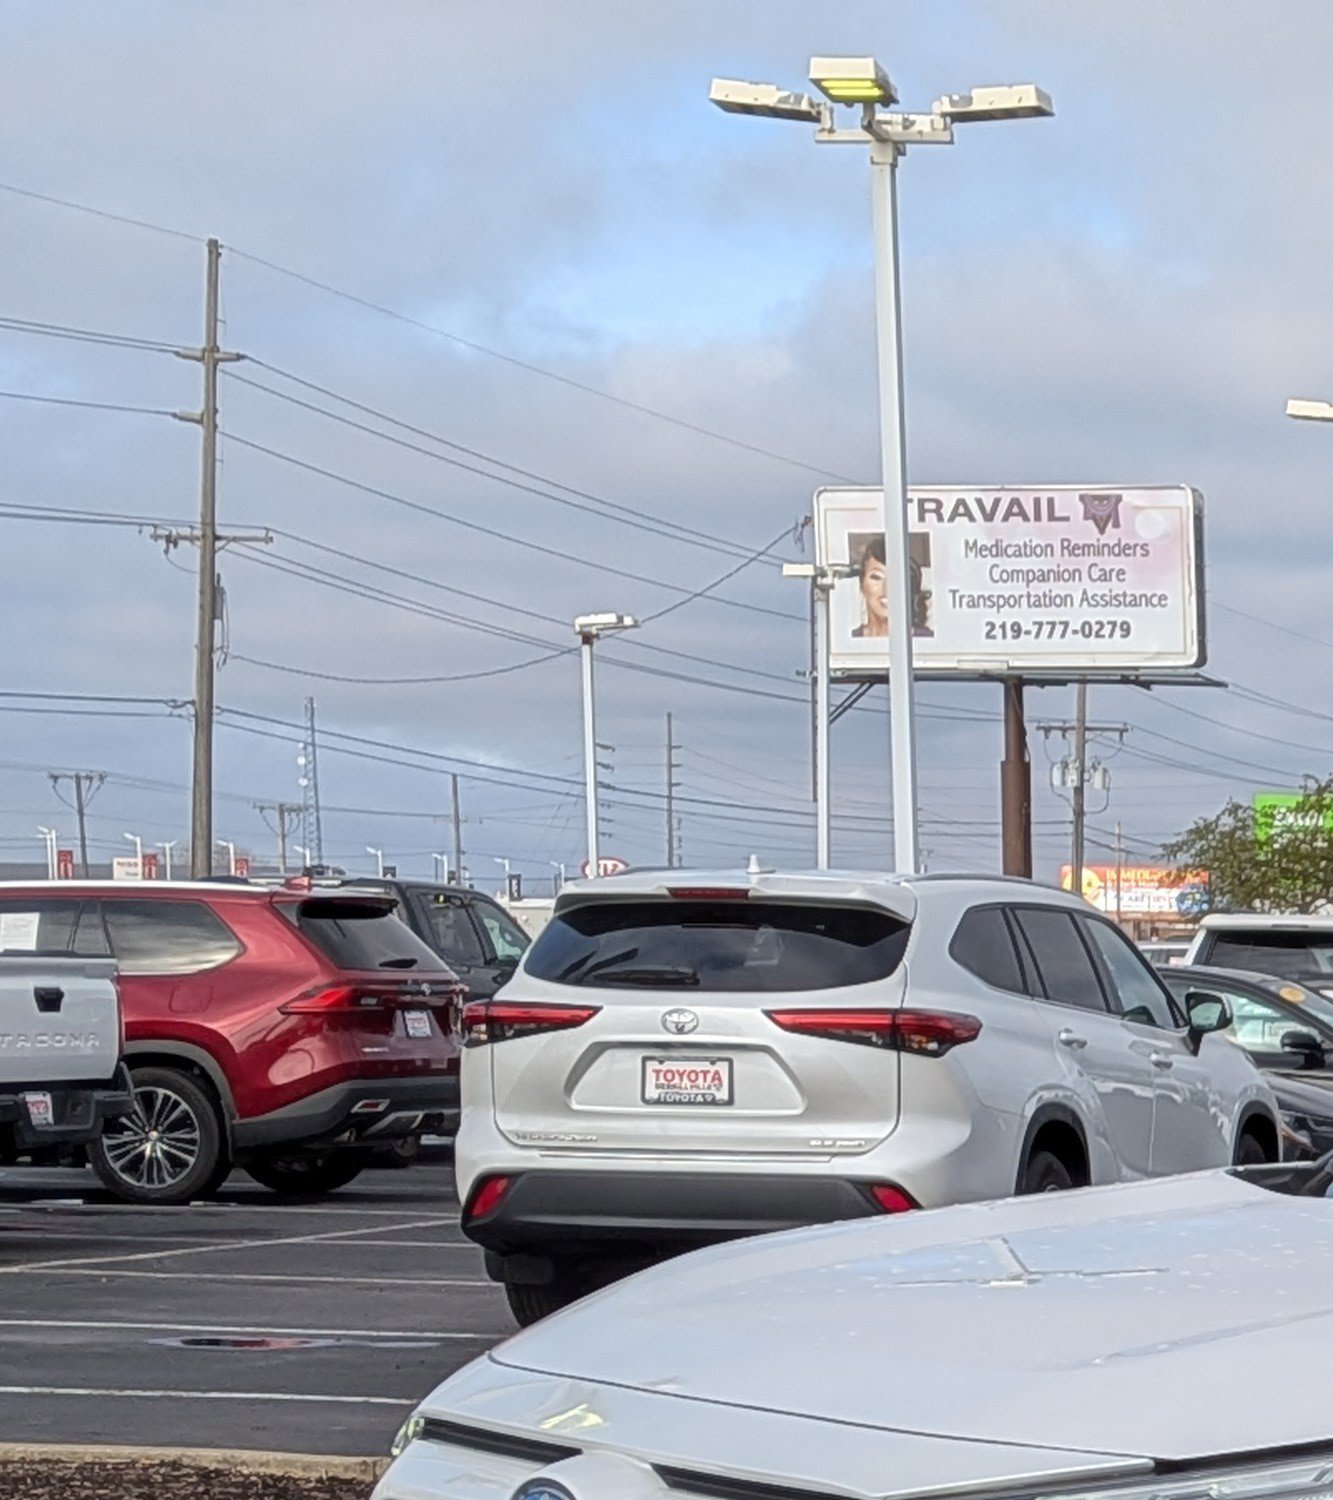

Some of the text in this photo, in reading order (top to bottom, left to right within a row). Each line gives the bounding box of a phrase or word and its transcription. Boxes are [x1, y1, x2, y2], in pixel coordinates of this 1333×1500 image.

[964, 538, 1150, 559] Medication Reminders
[989, 563, 1126, 587] Companion Care
[949, 588, 1168, 613] Transportation Assistance
[985, 620, 1131, 640] 219-777-0279
[0, 1033, 99, 1048] TACOMA
[652, 1069, 723, 1084] TOYOTA
